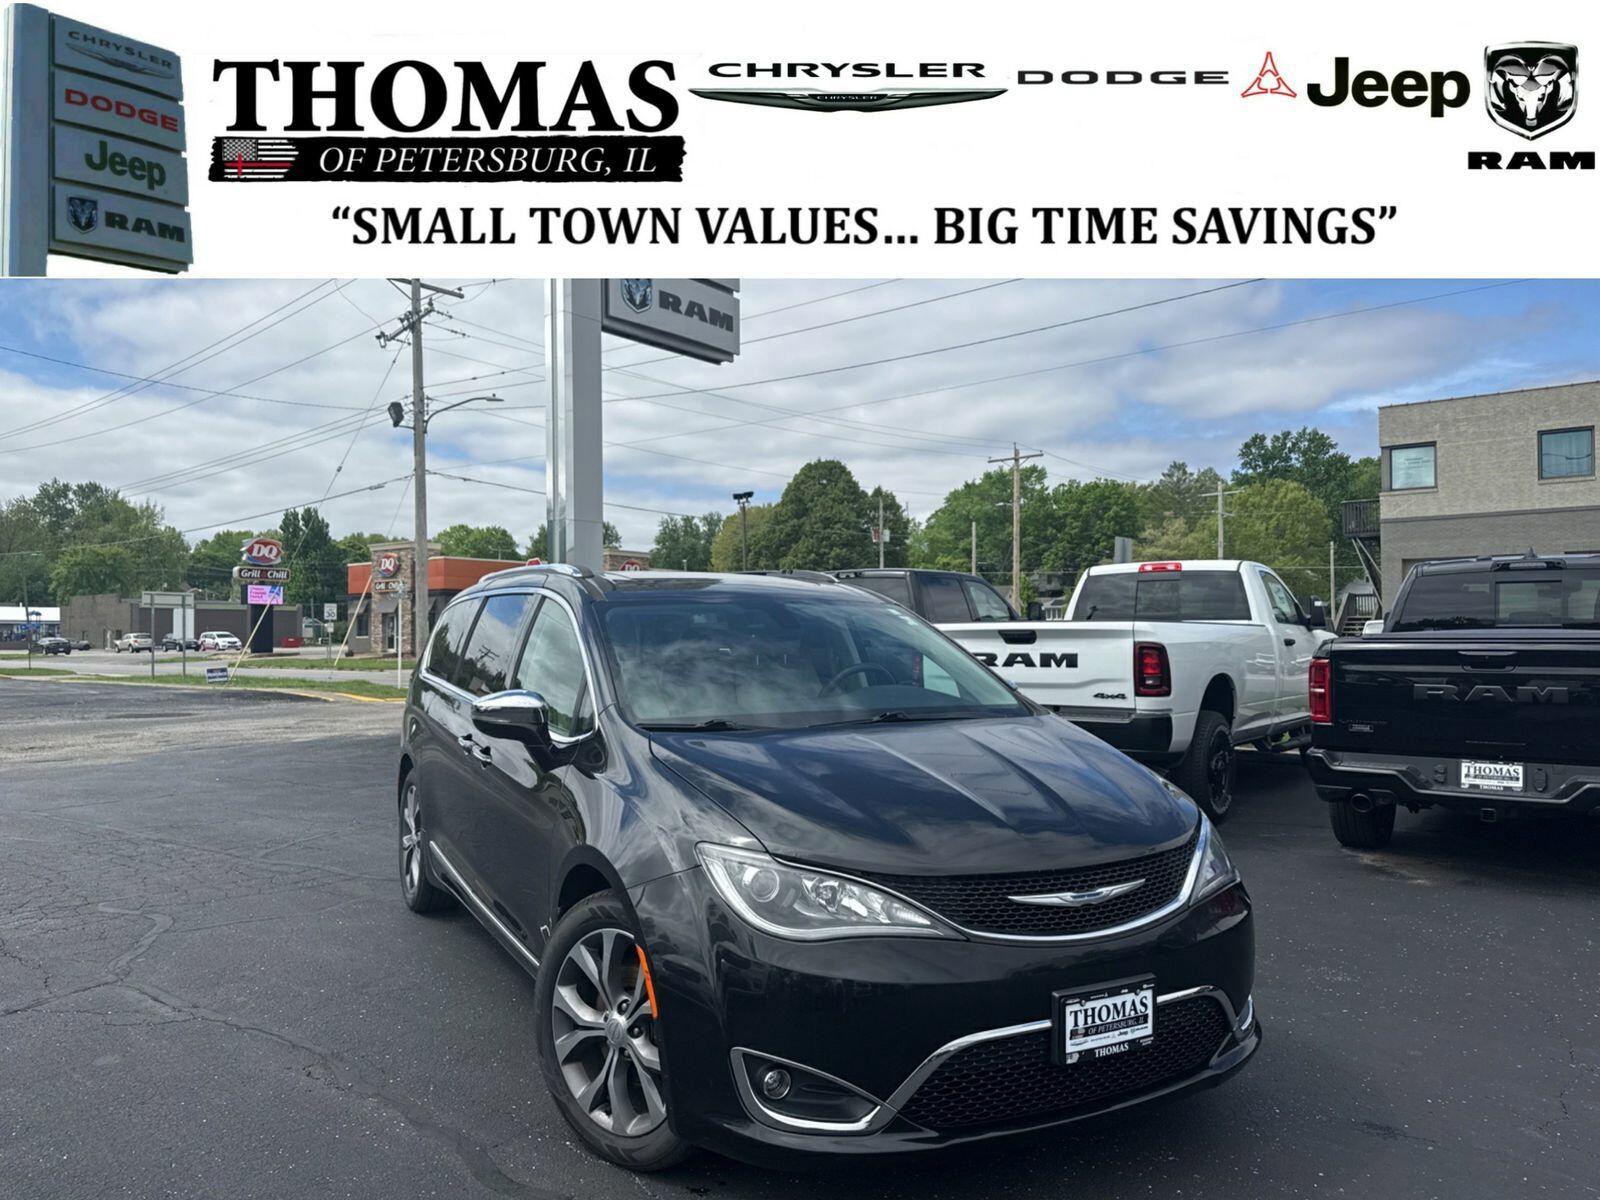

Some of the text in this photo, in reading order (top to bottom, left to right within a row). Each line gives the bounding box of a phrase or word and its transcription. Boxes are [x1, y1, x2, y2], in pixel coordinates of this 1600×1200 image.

[658, 289, 734, 333] RAM
[252, 543, 278, 560] DQ
[381, 558, 395, 571] DQ
[241, 569, 261, 578] Grill
[267, 570, 288, 579] Chill
[970, 652, 1079, 668] RAM
[1092, 692, 1128, 700] 4x4
[1413, 683, 1569, 704] RAM
[1464, 765, 1520, 777] THOMAS
[1070, 996, 1148, 1028] THOMAS
[1088, 1027, 1097, 1035] OF
[1094, 1042, 1129, 1058] THOMAS
